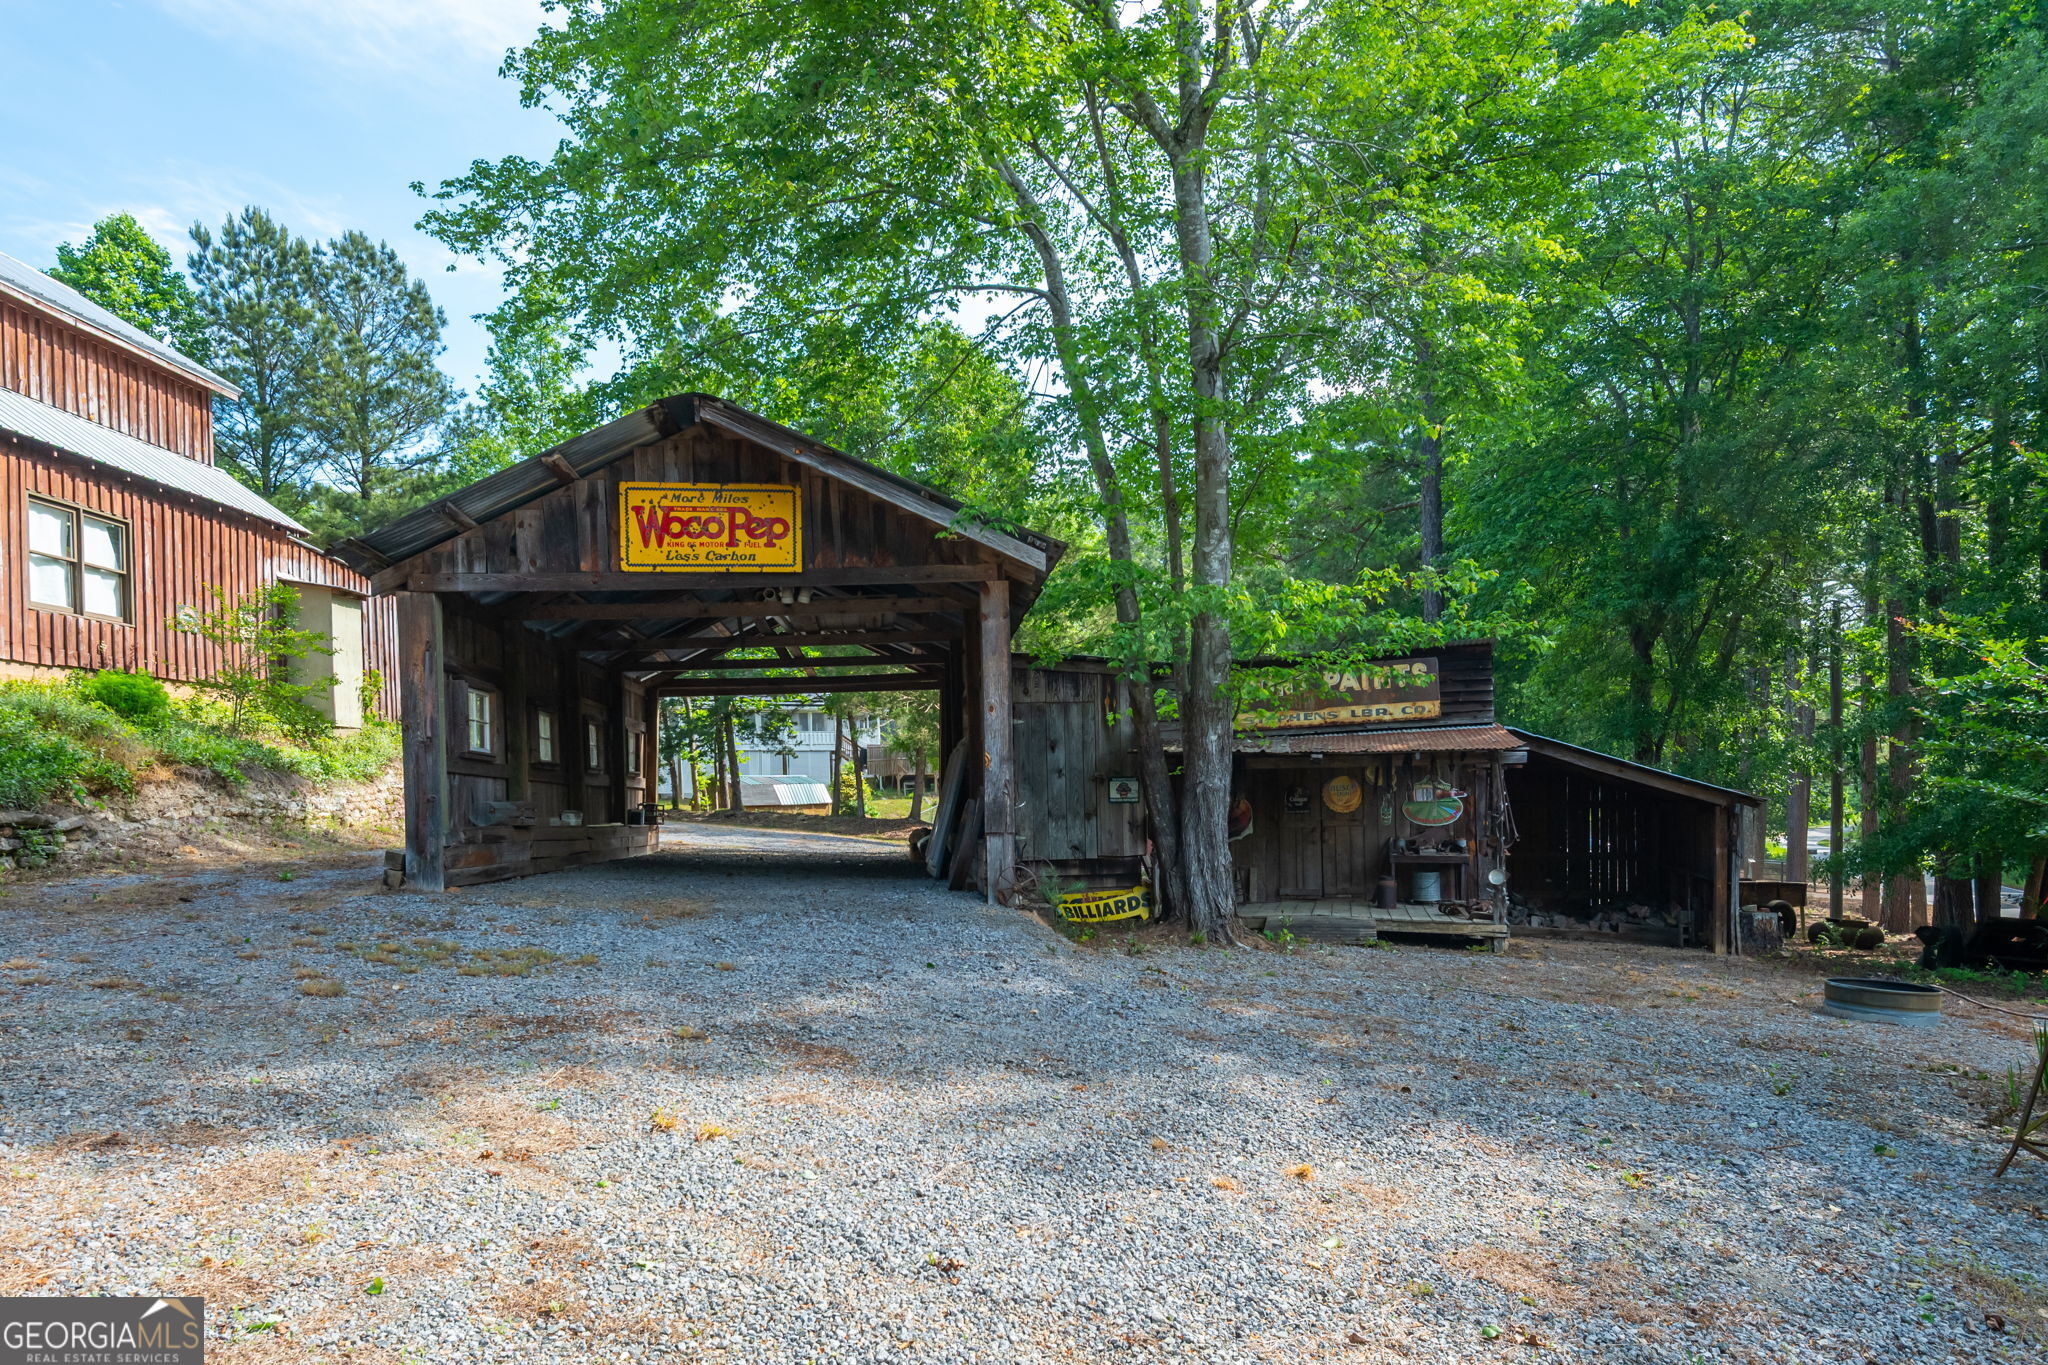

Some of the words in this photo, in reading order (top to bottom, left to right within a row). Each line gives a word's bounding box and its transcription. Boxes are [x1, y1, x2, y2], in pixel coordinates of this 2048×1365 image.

[670, 493, 705, 503] More
[712, 492, 750, 503] Miles
[666, 550, 700, 562] Less
[705, 550, 756, 562] Carbon
[1243, 711, 1339, 725] SPHENS
[1062, 892, 1150, 919] BILLIARDS
